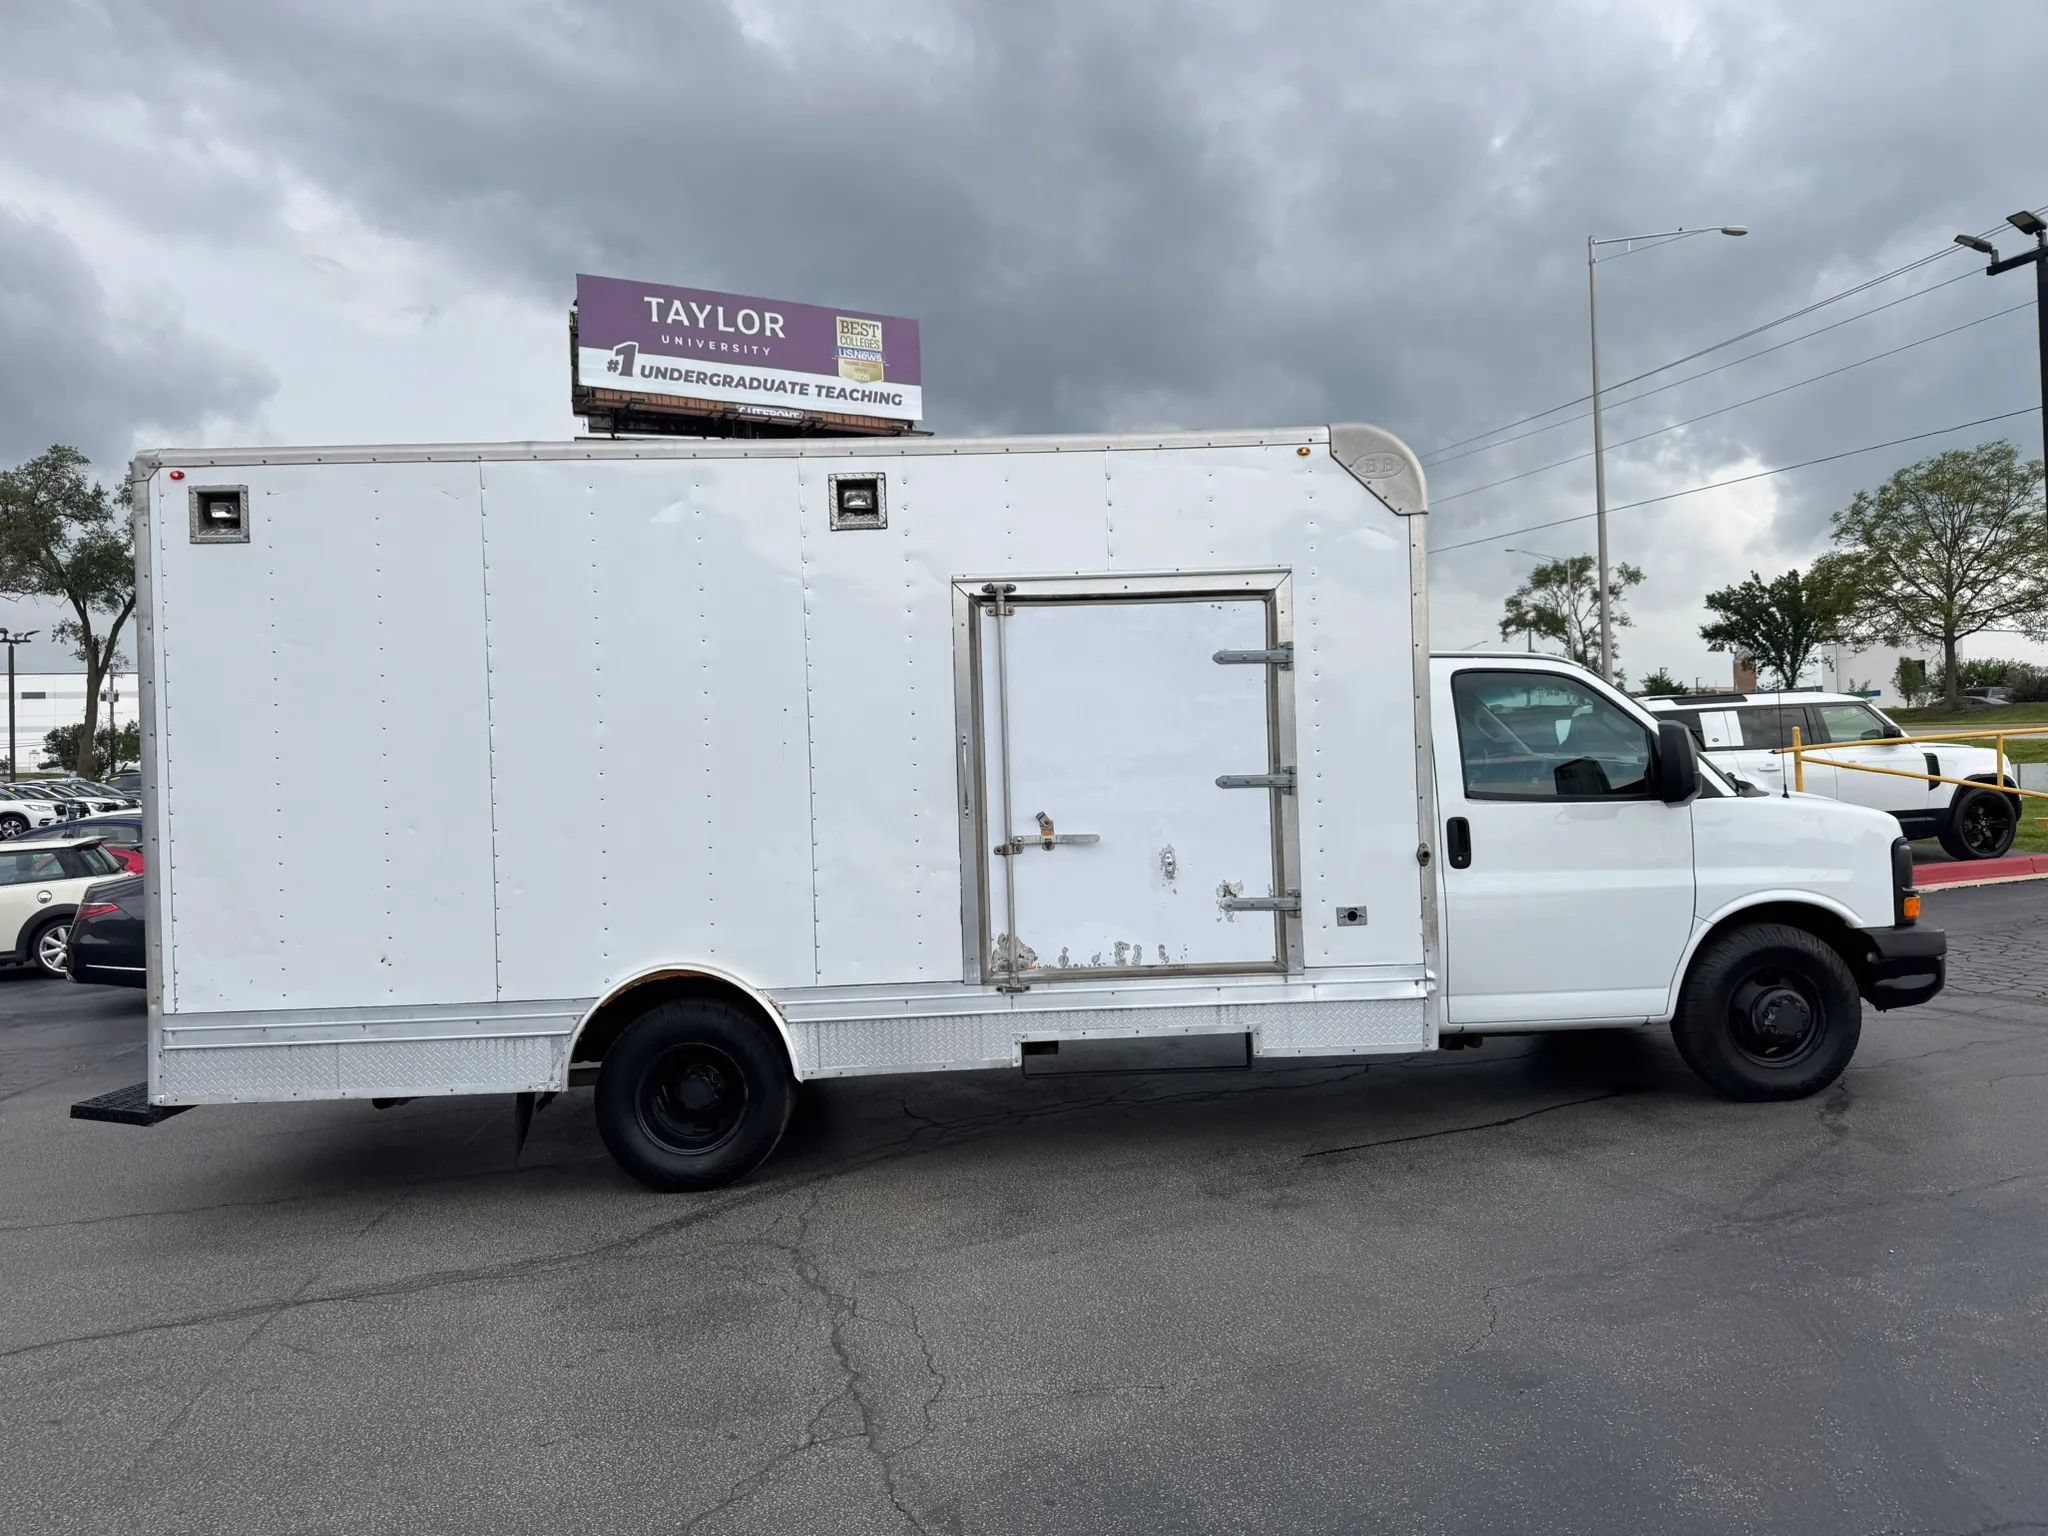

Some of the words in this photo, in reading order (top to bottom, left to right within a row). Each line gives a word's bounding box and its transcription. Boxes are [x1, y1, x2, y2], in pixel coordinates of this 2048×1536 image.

[643, 296, 786, 339] TAYLOR
[839, 320, 879, 338] BEST
[661, 335, 770, 356] UNIVERSITY
[840, 335, 880, 350] COLLEGES
[607, 342, 637, 377] #1
[640, 365, 810, 396] UNDERGRADUATE
[815, 384, 903, 406] TEACHING
